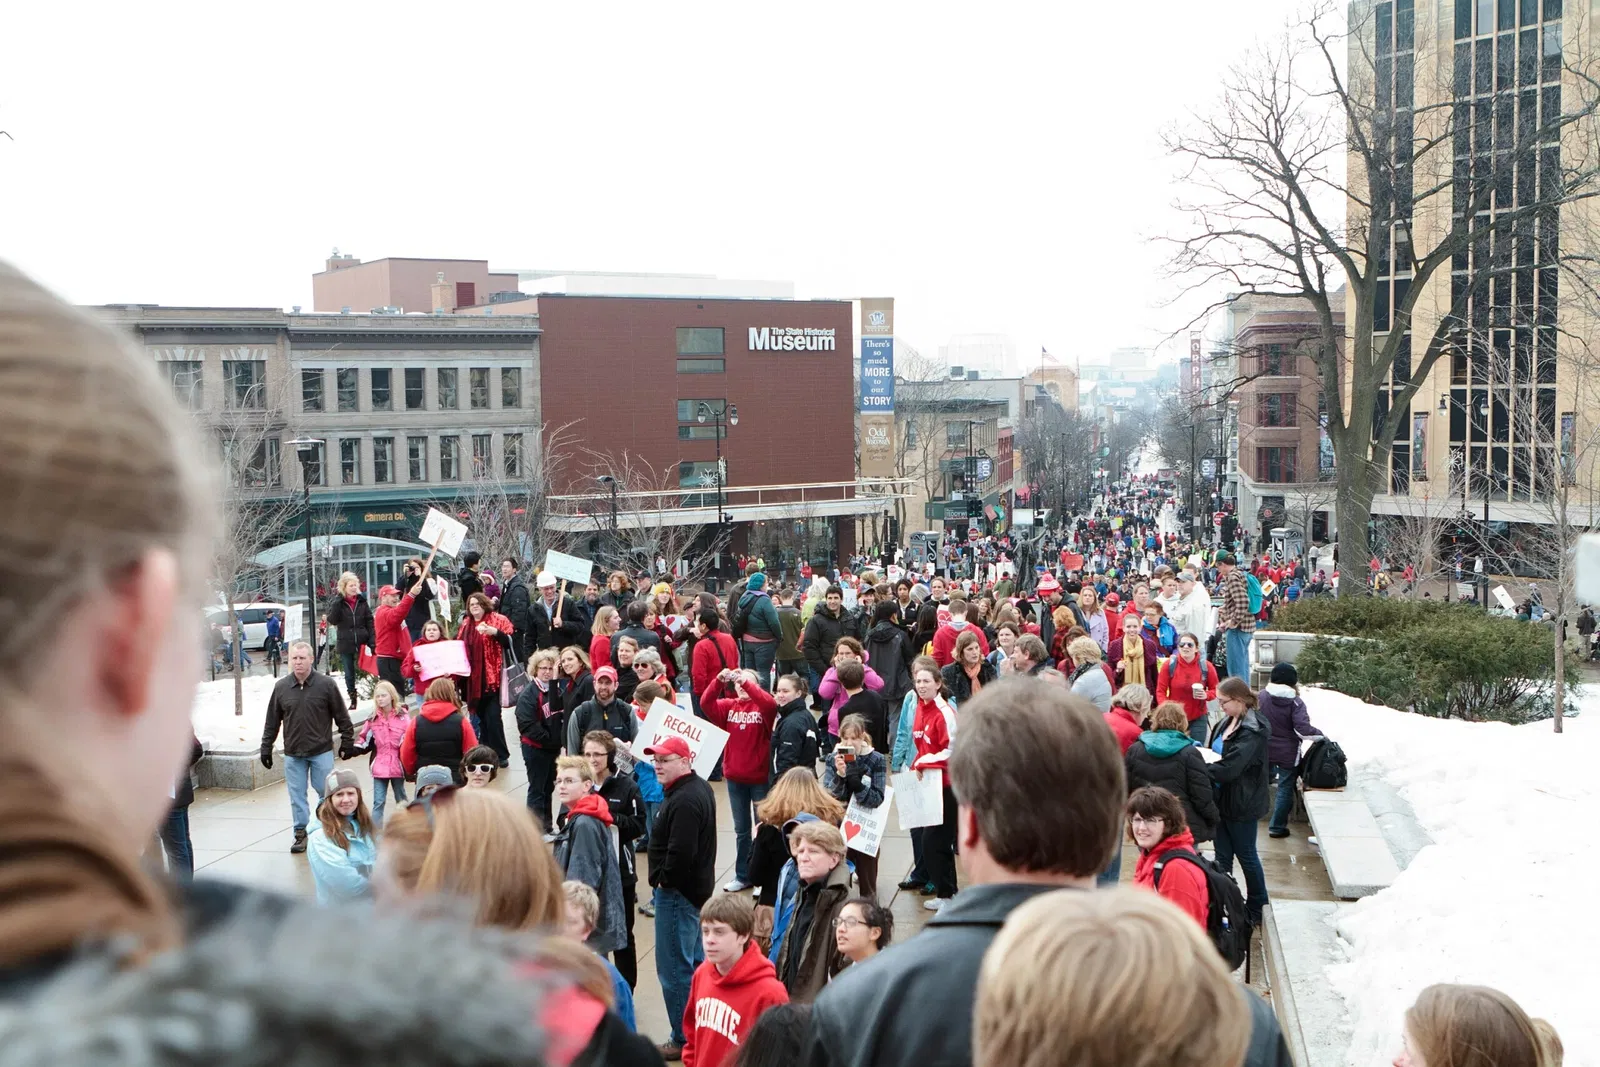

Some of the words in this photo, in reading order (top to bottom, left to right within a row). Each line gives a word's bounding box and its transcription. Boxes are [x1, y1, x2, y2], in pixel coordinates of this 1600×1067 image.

[770, 327, 785, 335] The
[785, 327, 803, 335] State
[804, 328, 835, 336] Historical
[748, 327, 836, 351] Museum
[865, 340, 890, 348] There's
[864, 367, 891, 377] MORE
[863, 396, 892, 406] STORY
[868, 427, 886, 437] Odd
[727, 709, 763, 724] BADGERS
[663, 714, 703, 743] RECALL
